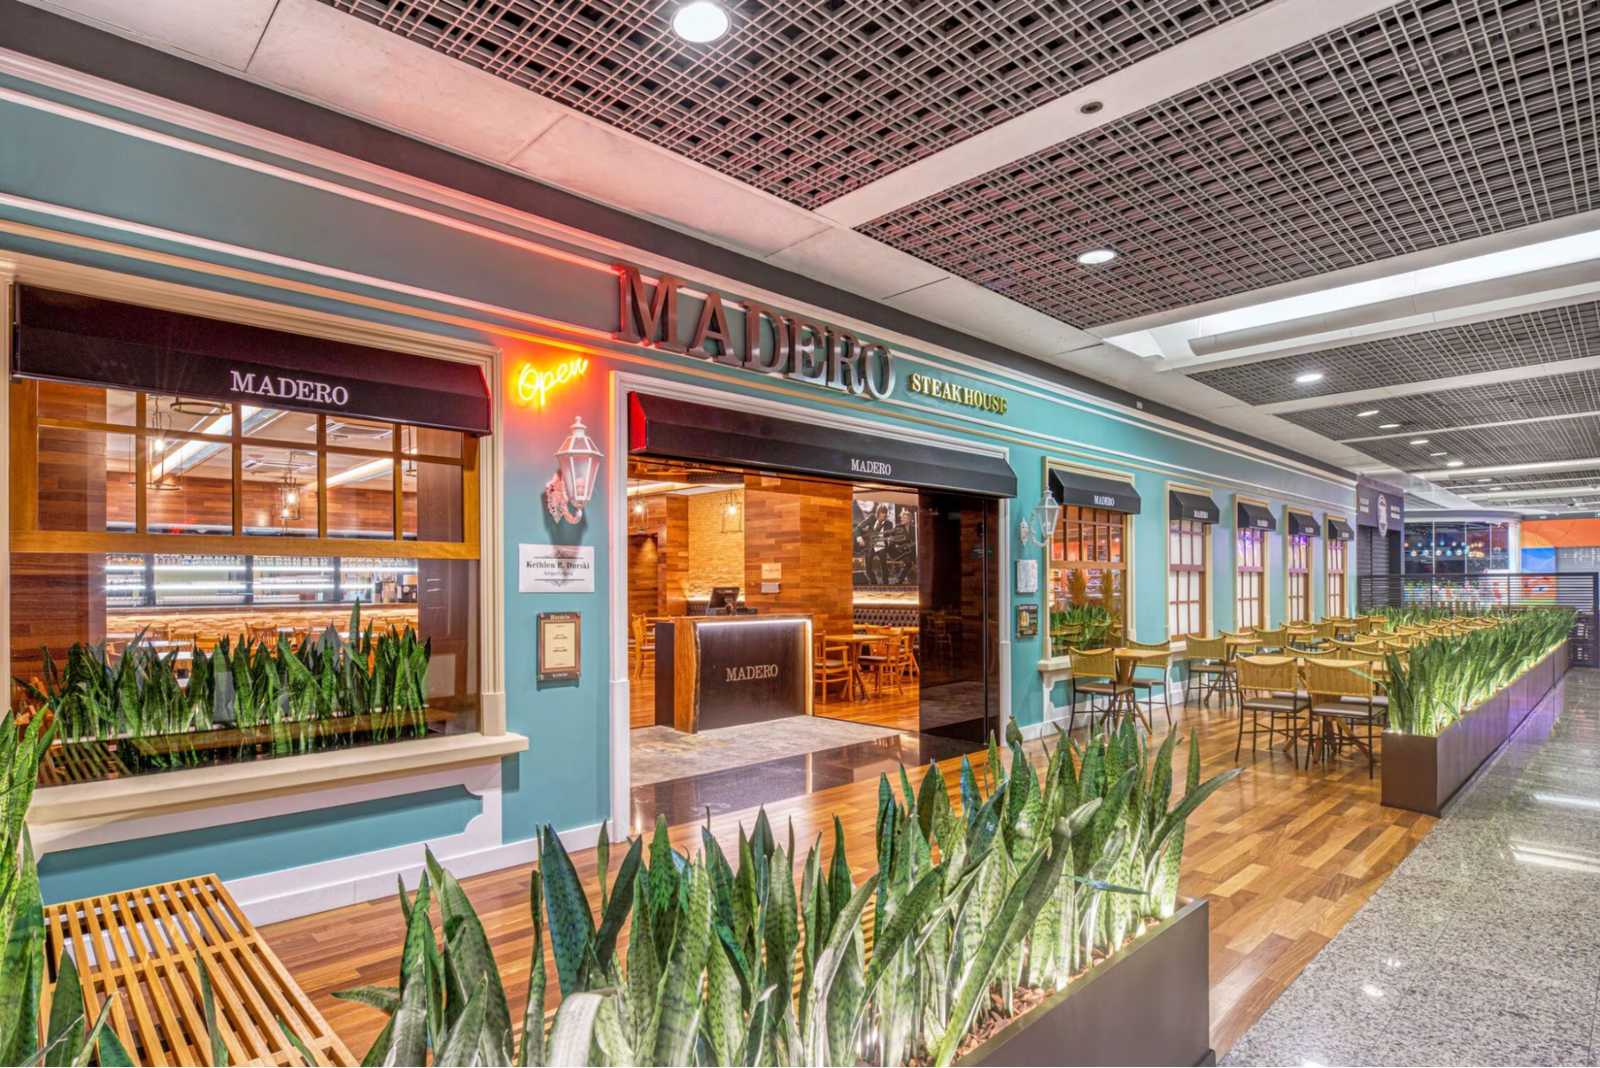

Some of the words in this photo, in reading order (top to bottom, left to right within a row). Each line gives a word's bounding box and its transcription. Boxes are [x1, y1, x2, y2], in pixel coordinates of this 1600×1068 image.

[611, 262, 897, 400] MADERO
[230, 370, 348, 405] MADERO
[518, 357, 589, 406] Open
[911, 373, 962, 403] STEAK
[963, 387, 1008, 414] HOUSE
[851, 458, 892, 476] MADERO
[1094, 495, 1115, 507] MADERO
[526, 561, 555, 569] Kethlen
[566, 561, 590, 570] Durski
[726, 663, 779, 682] MADERO
